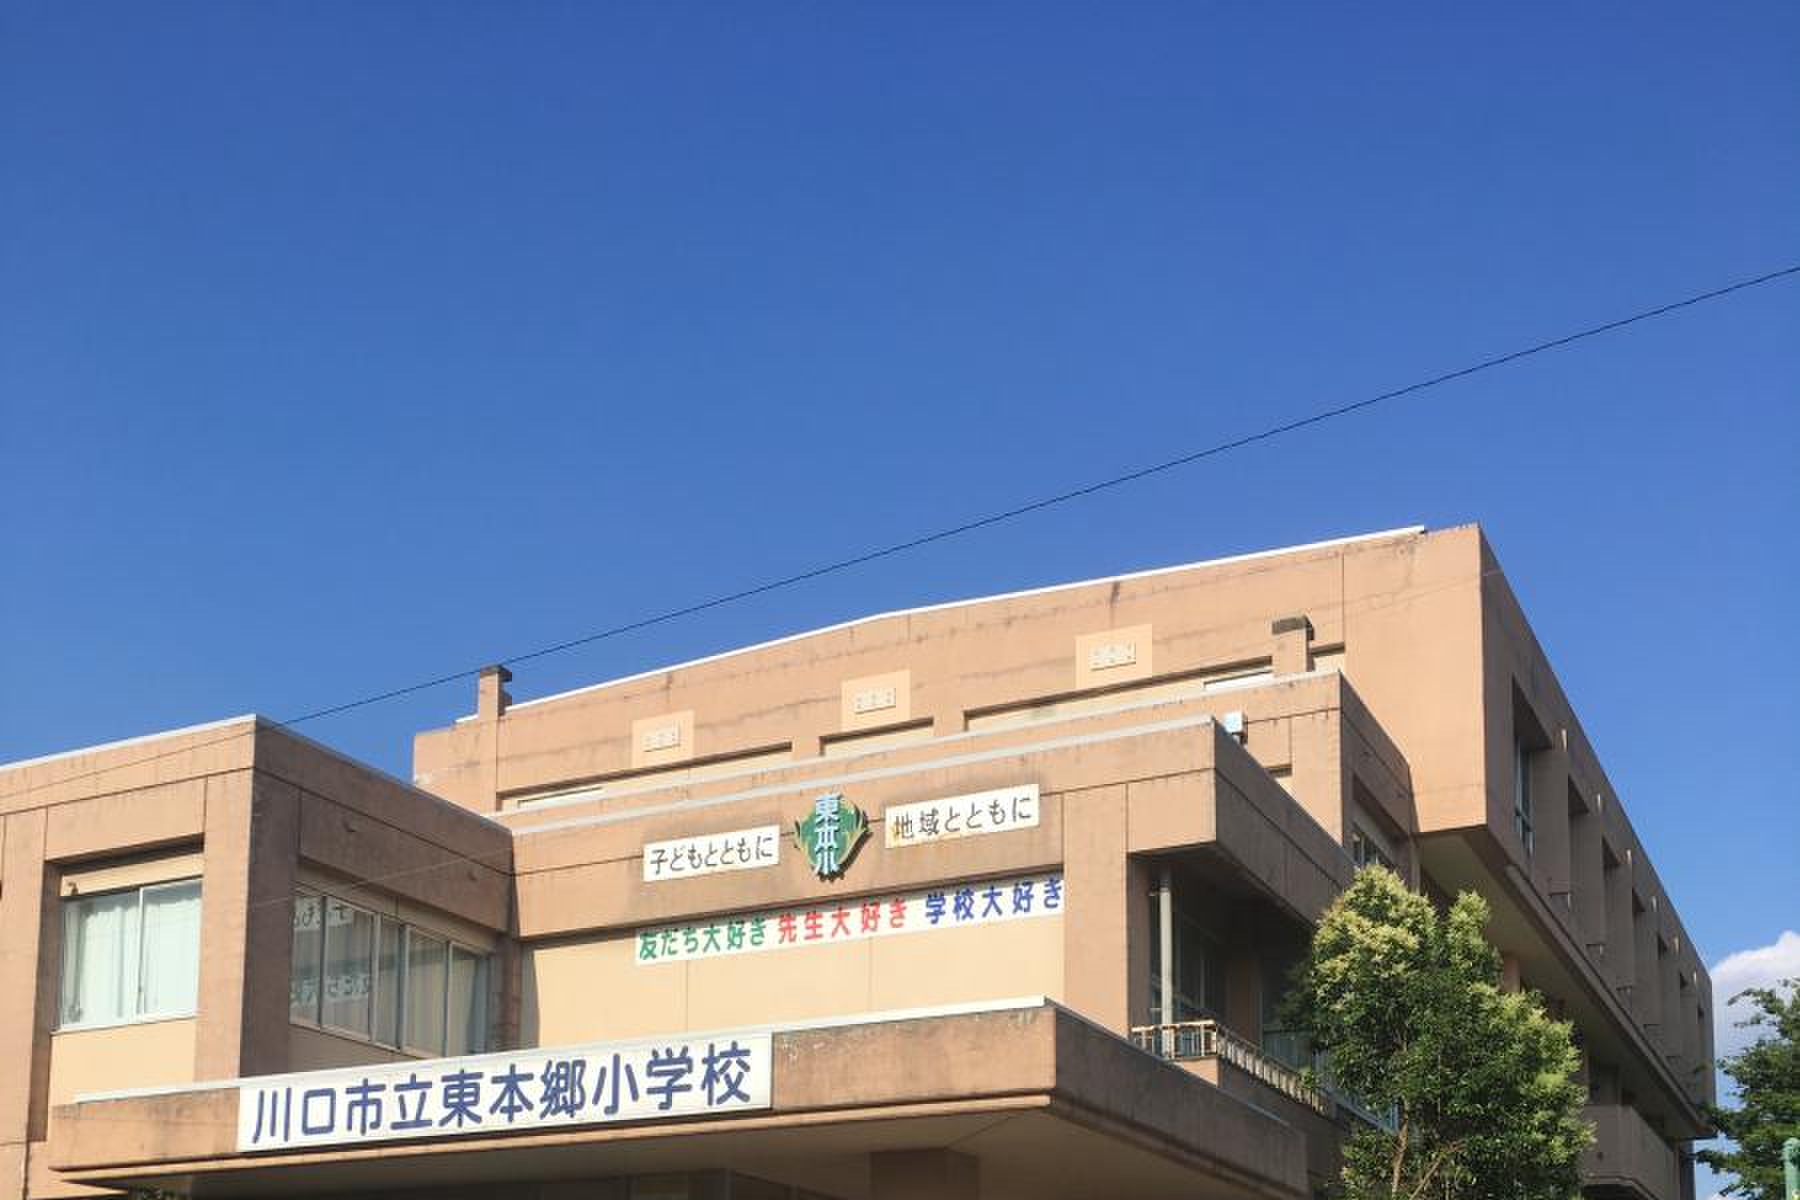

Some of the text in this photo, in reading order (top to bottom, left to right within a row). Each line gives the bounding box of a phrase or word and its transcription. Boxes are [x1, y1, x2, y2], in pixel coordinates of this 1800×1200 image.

[894, 796, 1033, 840] 地域とともに
[649, 835, 774, 875] 子どもとともに
[639, 877, 1063, 960] 友だち大好き 先生大好き 学校大好き
[252, 1041, 752, 1144] 川口市立東本郷小学校
